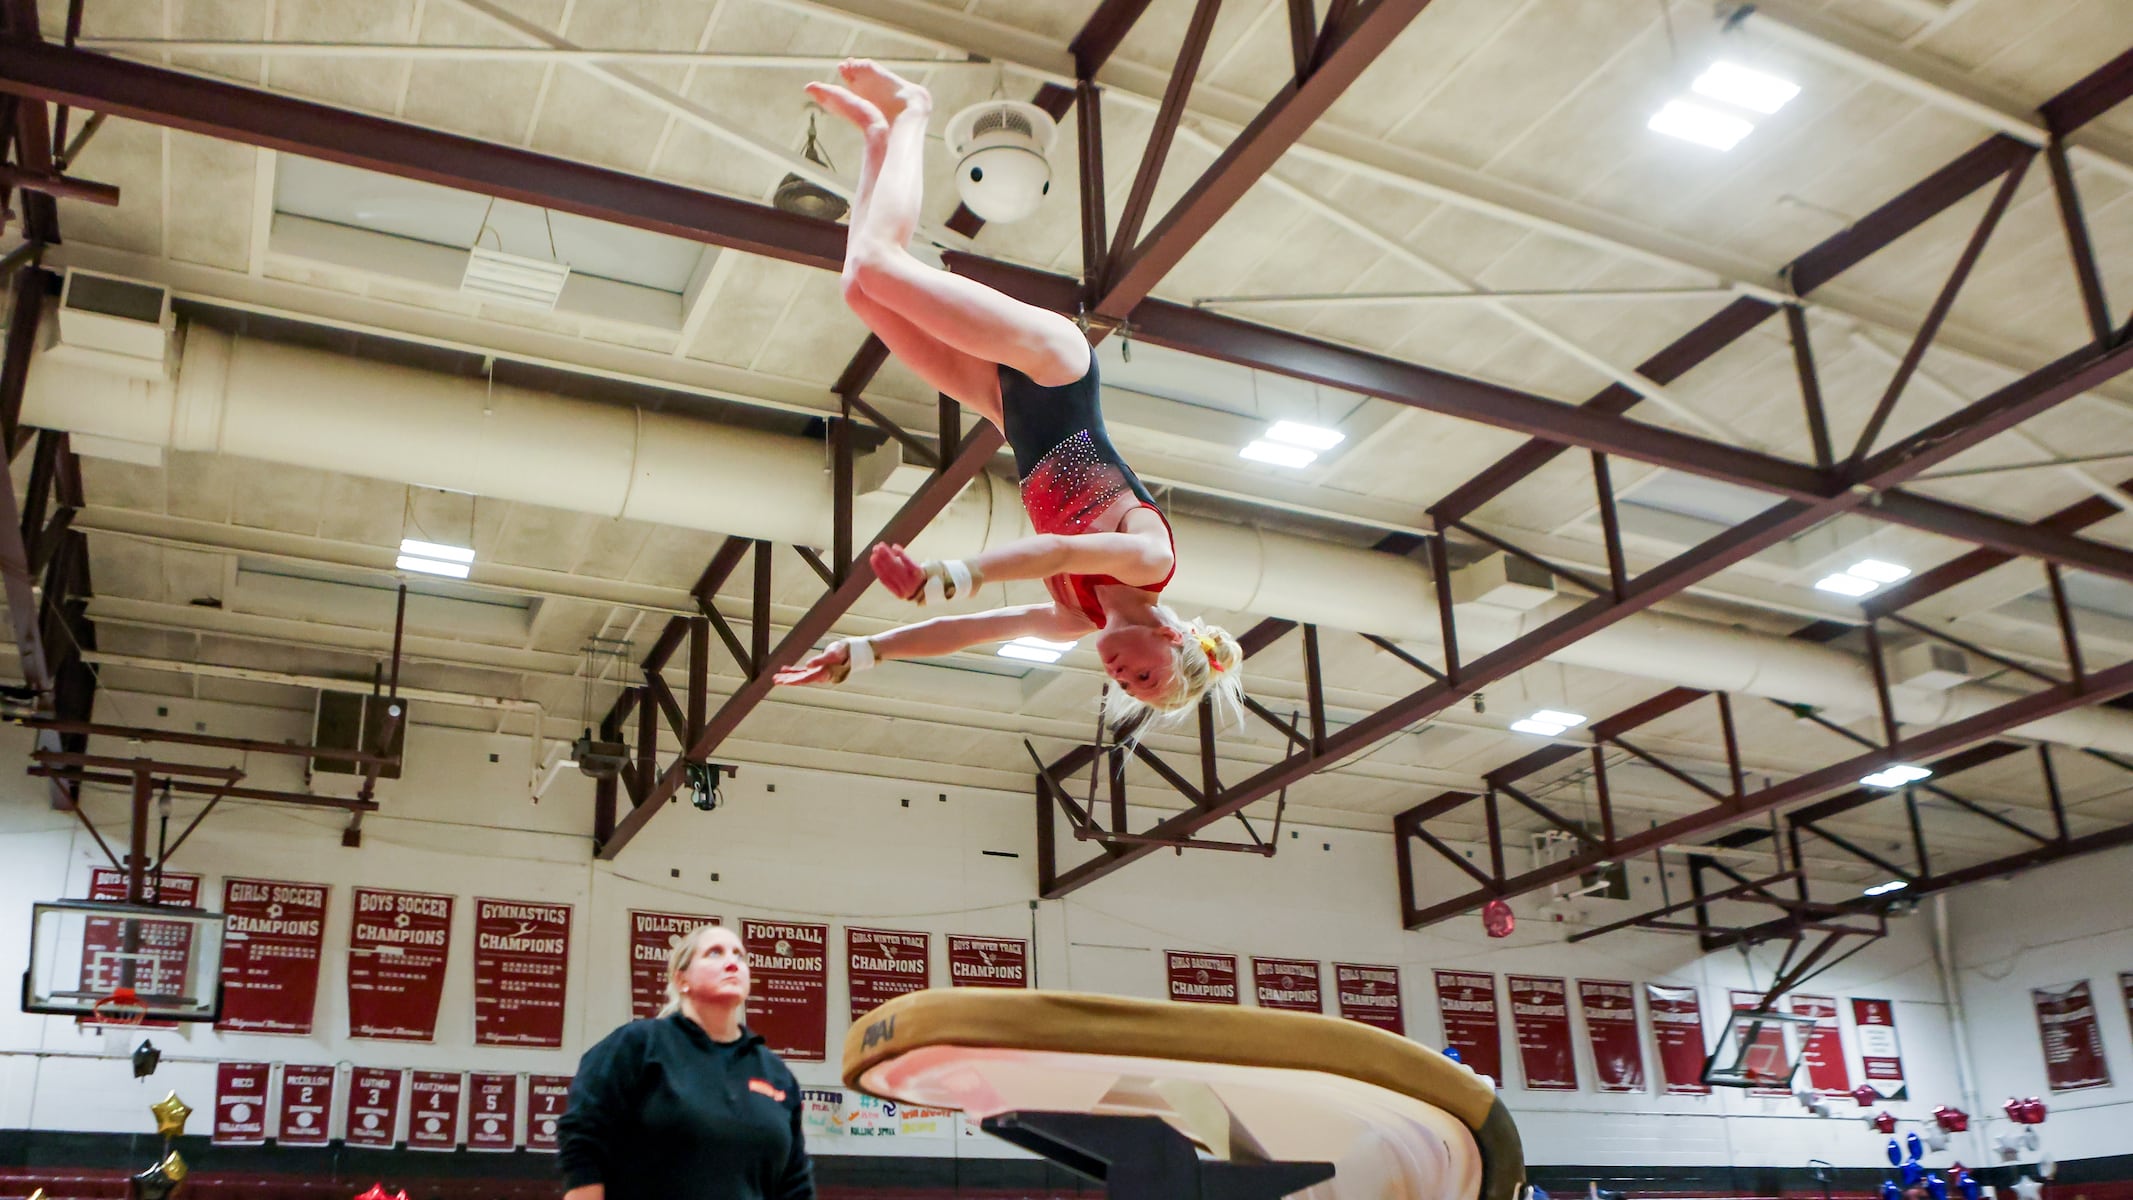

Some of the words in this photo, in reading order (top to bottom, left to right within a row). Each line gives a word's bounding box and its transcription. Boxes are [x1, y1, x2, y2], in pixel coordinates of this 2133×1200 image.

[230, 883, 269, 902] GIRLS
[272, 887, 322, 908] SOCCER
[360, 893, 393, 912] BOYS
[397, 896, 447, 918] SOCCER
[482, 903, 566, 924] GYMNASTICS
[227, 914, 319, 936] CHAMPIONS
[357, 923, 445, 945] CHAMPIONS
[637, 916, 714, 934] VOLLEYBA
[747, 924, 822, 944] FOOTBALL
[480, 933, 564, 954] CHAMPIONS
[852, 932, 872, 943] GIRLS
[874, 934, 900, 945] WINTER
[902, 936, 925, 949] TRACK
[953, 939, 970, 951] BOYS
[972, 941, 998, 952] WINTER
[1000, 943, 1022, 955] TRACK
[748, 952, 822, 971] CHAMPIONS
[852, 954, 924, 973] CHAMPIONS
[953, 961, 1022, 979] CHAMPIONS
[1191, 957, 1233, 973] BASKETBALL
[1172, 981, 1234, 998] CHAMPIONS
[1259, 987, 1318, 1003] CHAMPIONS
[301, 1086, 313, 1103] 2
[368, 1088, 380, 1105] 3
[430, 1093, 440, 1109] 4
[486, 1094, 497, 1111] 5
[545, 1095, 556, 1112] 7
